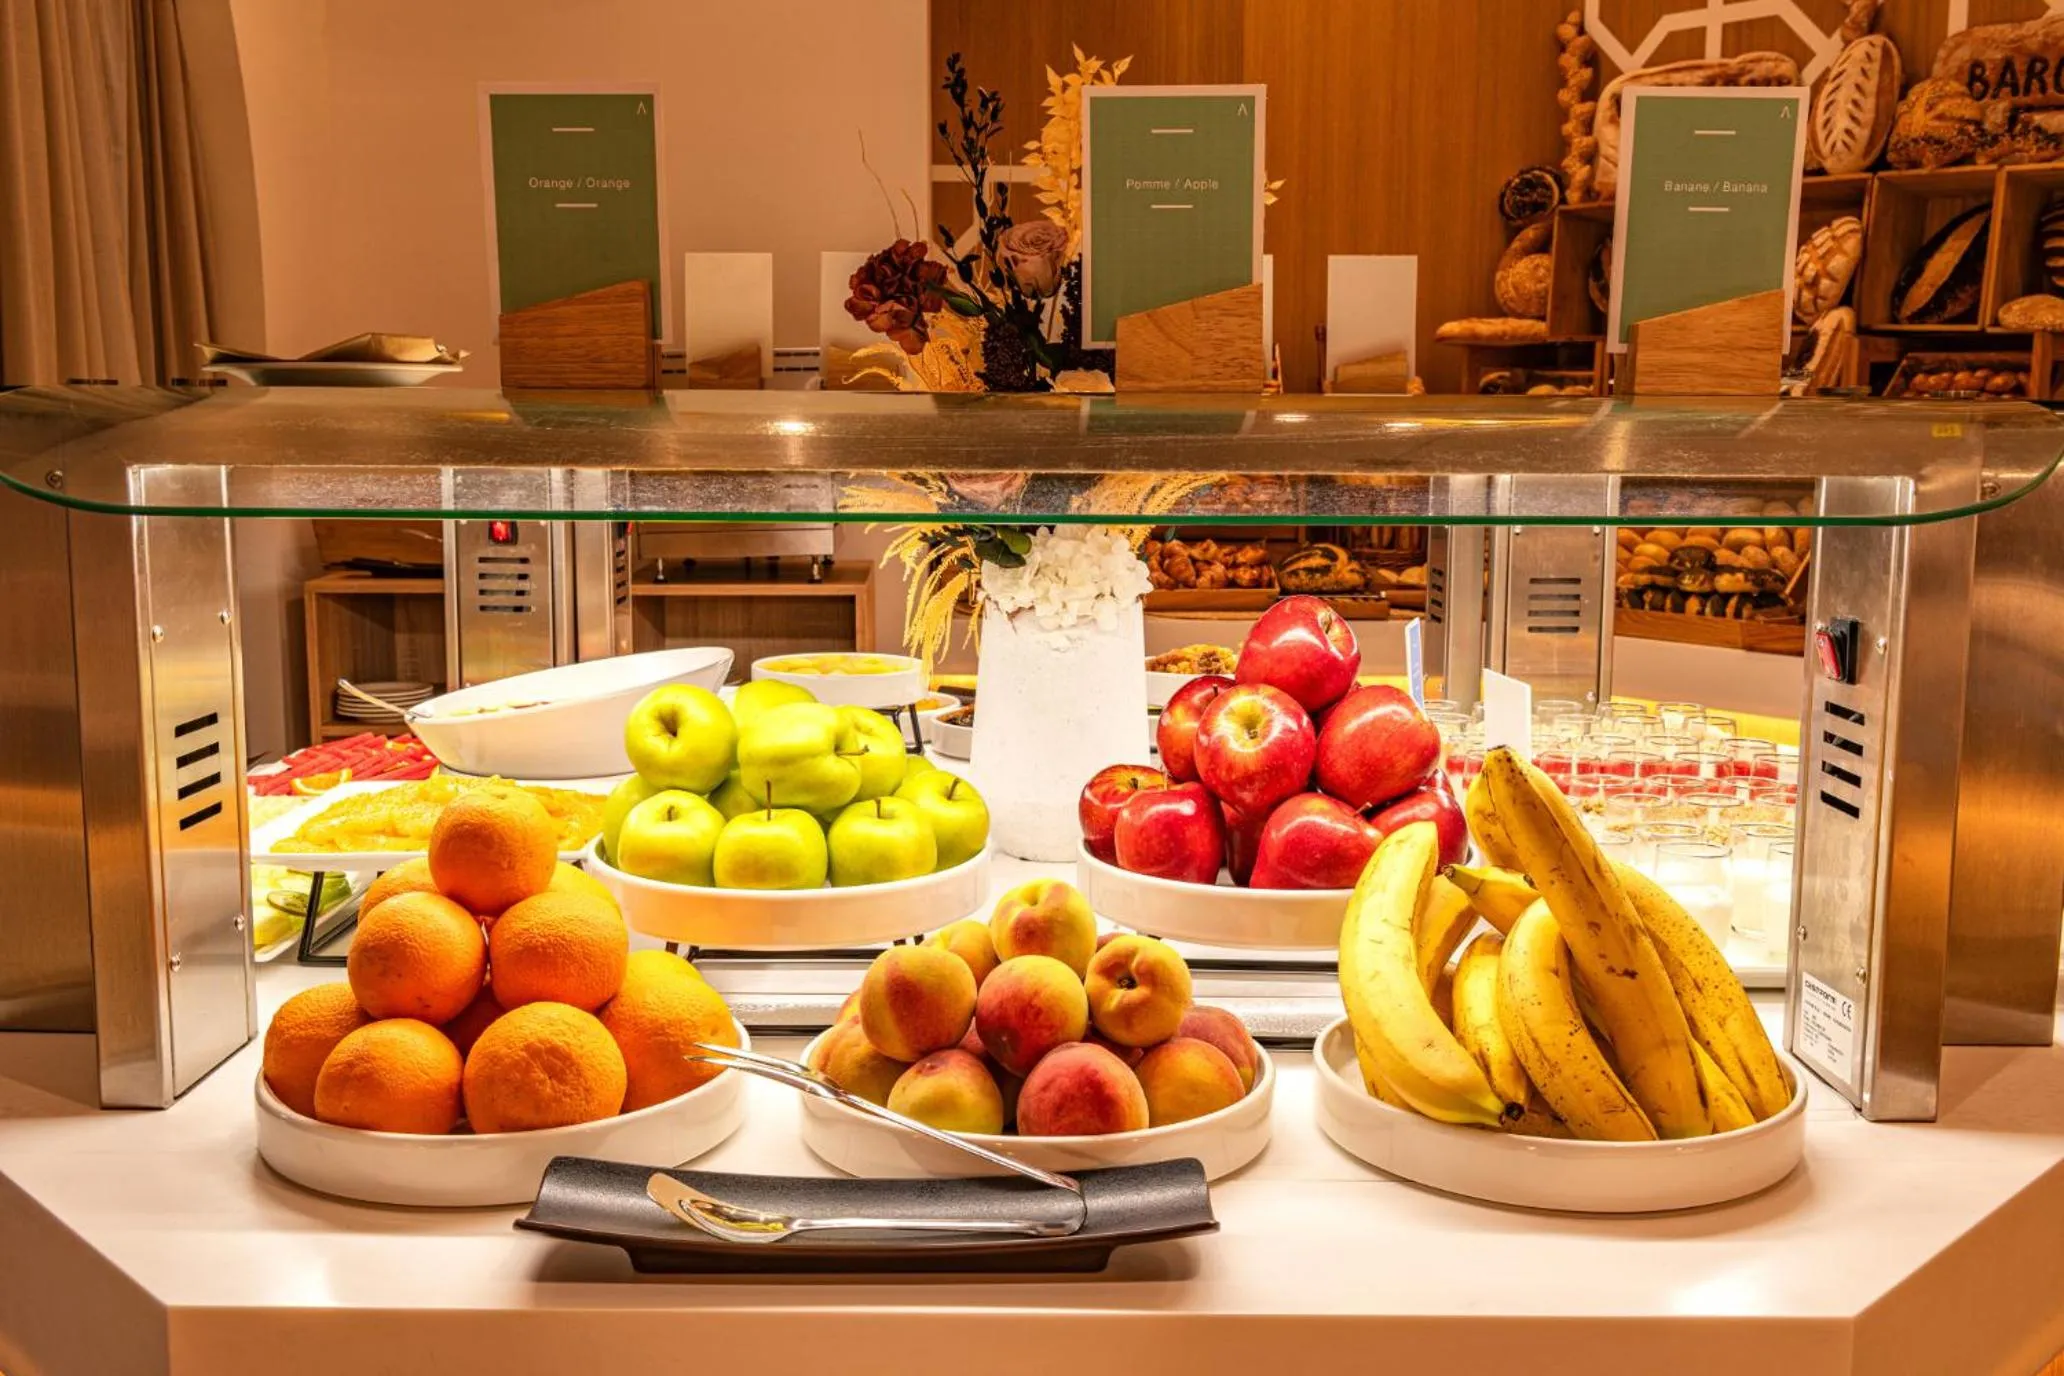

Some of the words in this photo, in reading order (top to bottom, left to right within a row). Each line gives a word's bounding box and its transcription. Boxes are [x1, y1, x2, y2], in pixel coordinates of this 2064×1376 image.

[528, 177, 573, 191] Orange
[585, 177, 631, 191] Orange
[1126, 178, 1171, 190] Pomme
[1184, 178, 1219, 192] Apple
[1664, 180, 1710, 192] Banane
[1722, 181, 1768, 193] Banana
